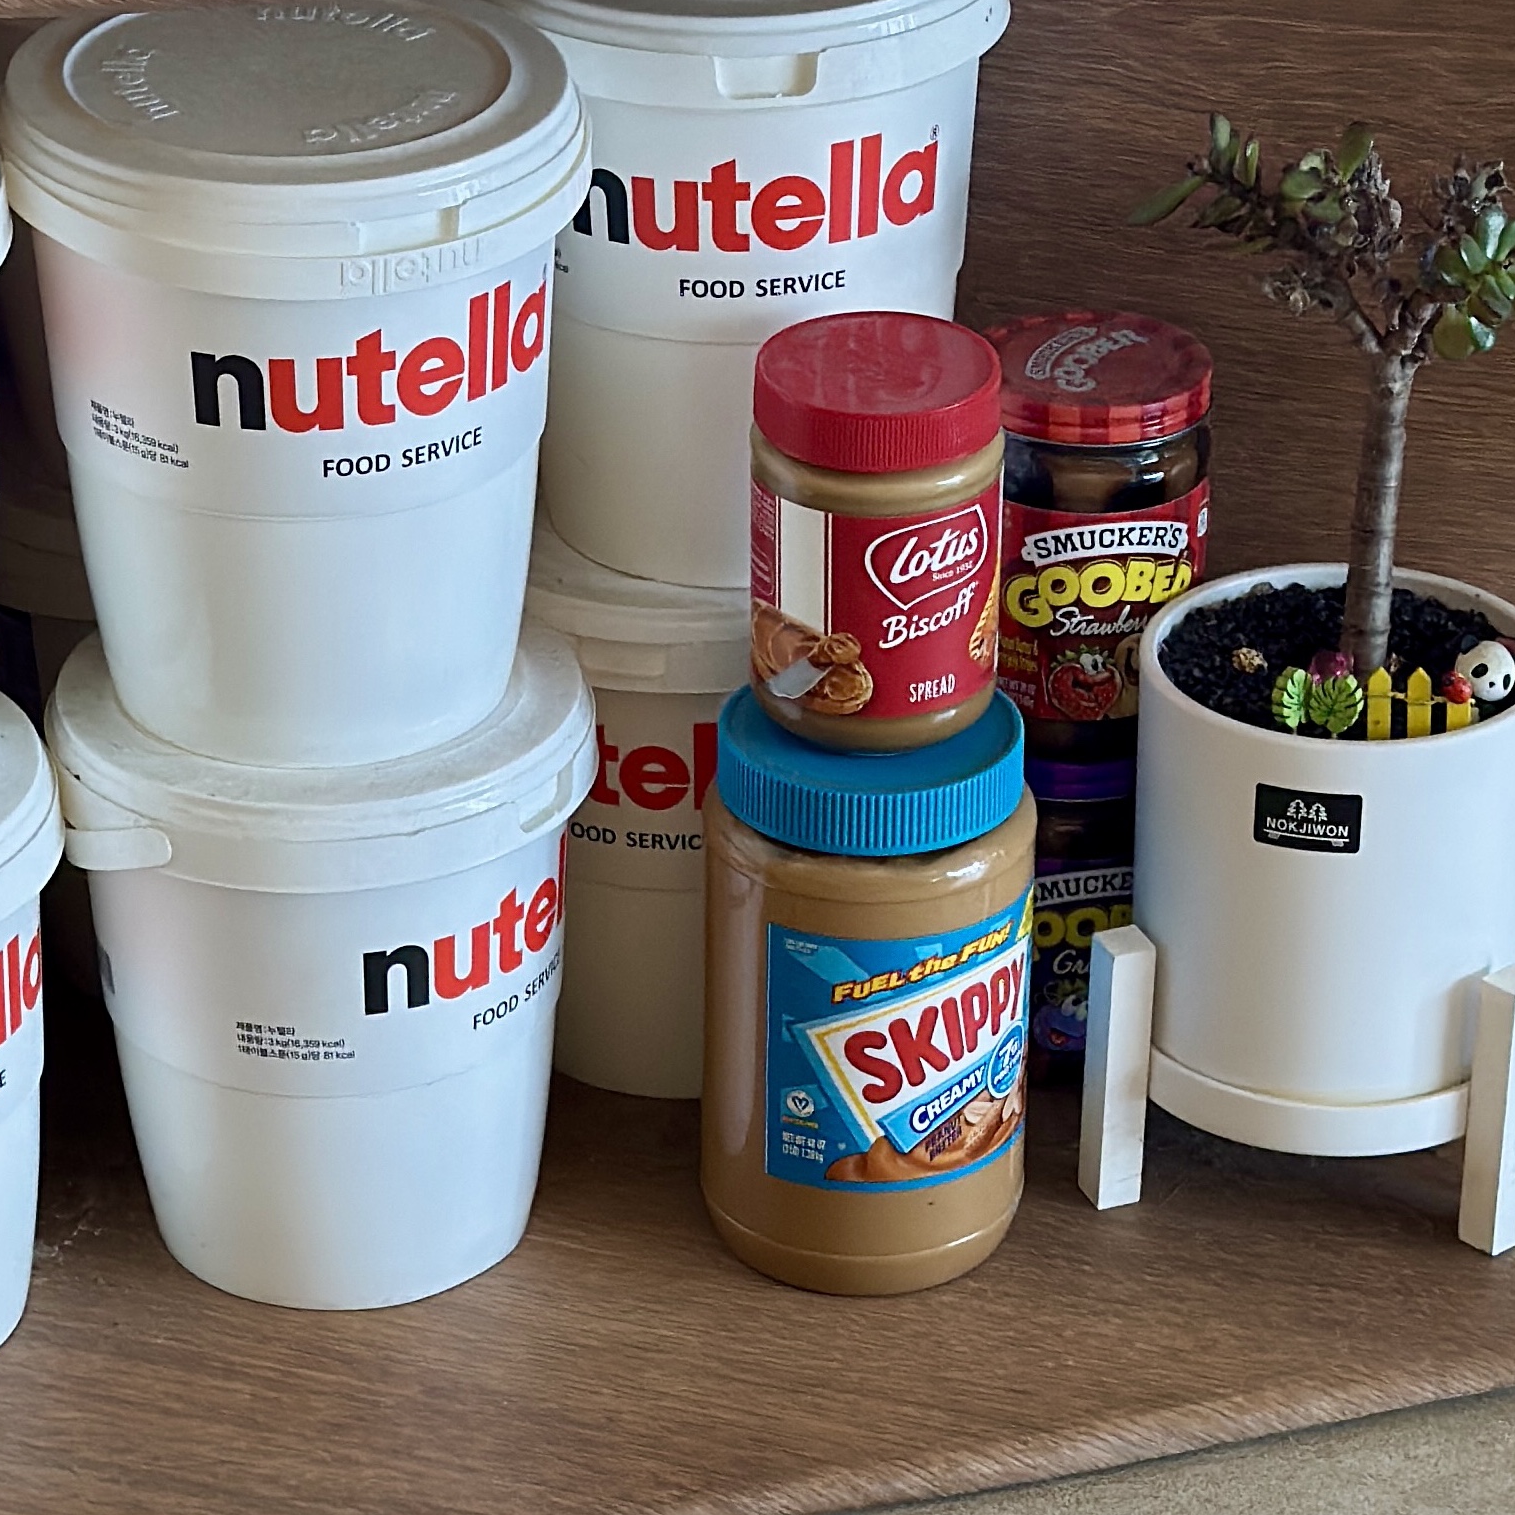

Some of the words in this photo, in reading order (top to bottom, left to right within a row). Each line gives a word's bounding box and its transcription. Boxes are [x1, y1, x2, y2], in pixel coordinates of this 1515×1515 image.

[573, 133, 939, 253] nutella
[679, 278, 745, 299] FOOD
[755, 269, 847, 297] SERVICE
[190, 279, 547, 433] nutella
[323, 453, 391, 478] FOOD
[401, 426, 483, 469] SERVICE
[889, 528, 979, 584] Lotus
[1034, 523, 1183, 559] SMUCKER'S
[879, 582, 976, 649] Biscoff
[909, 673, 956, 703] SPREAD
[570, 821, 617, 845] OOD
[626, 831, 703, 850] SERVIC
[831, 971, 908, 1005] FUEL
[909, 954, 956, 983] the
[958, 921, 1014, 965] FUN!
[473, 994, 518, 1030] FOOD
[844, 951, 1026, 1105] SKIPPY
[912, 1064, 986, 1132] CREAMY
